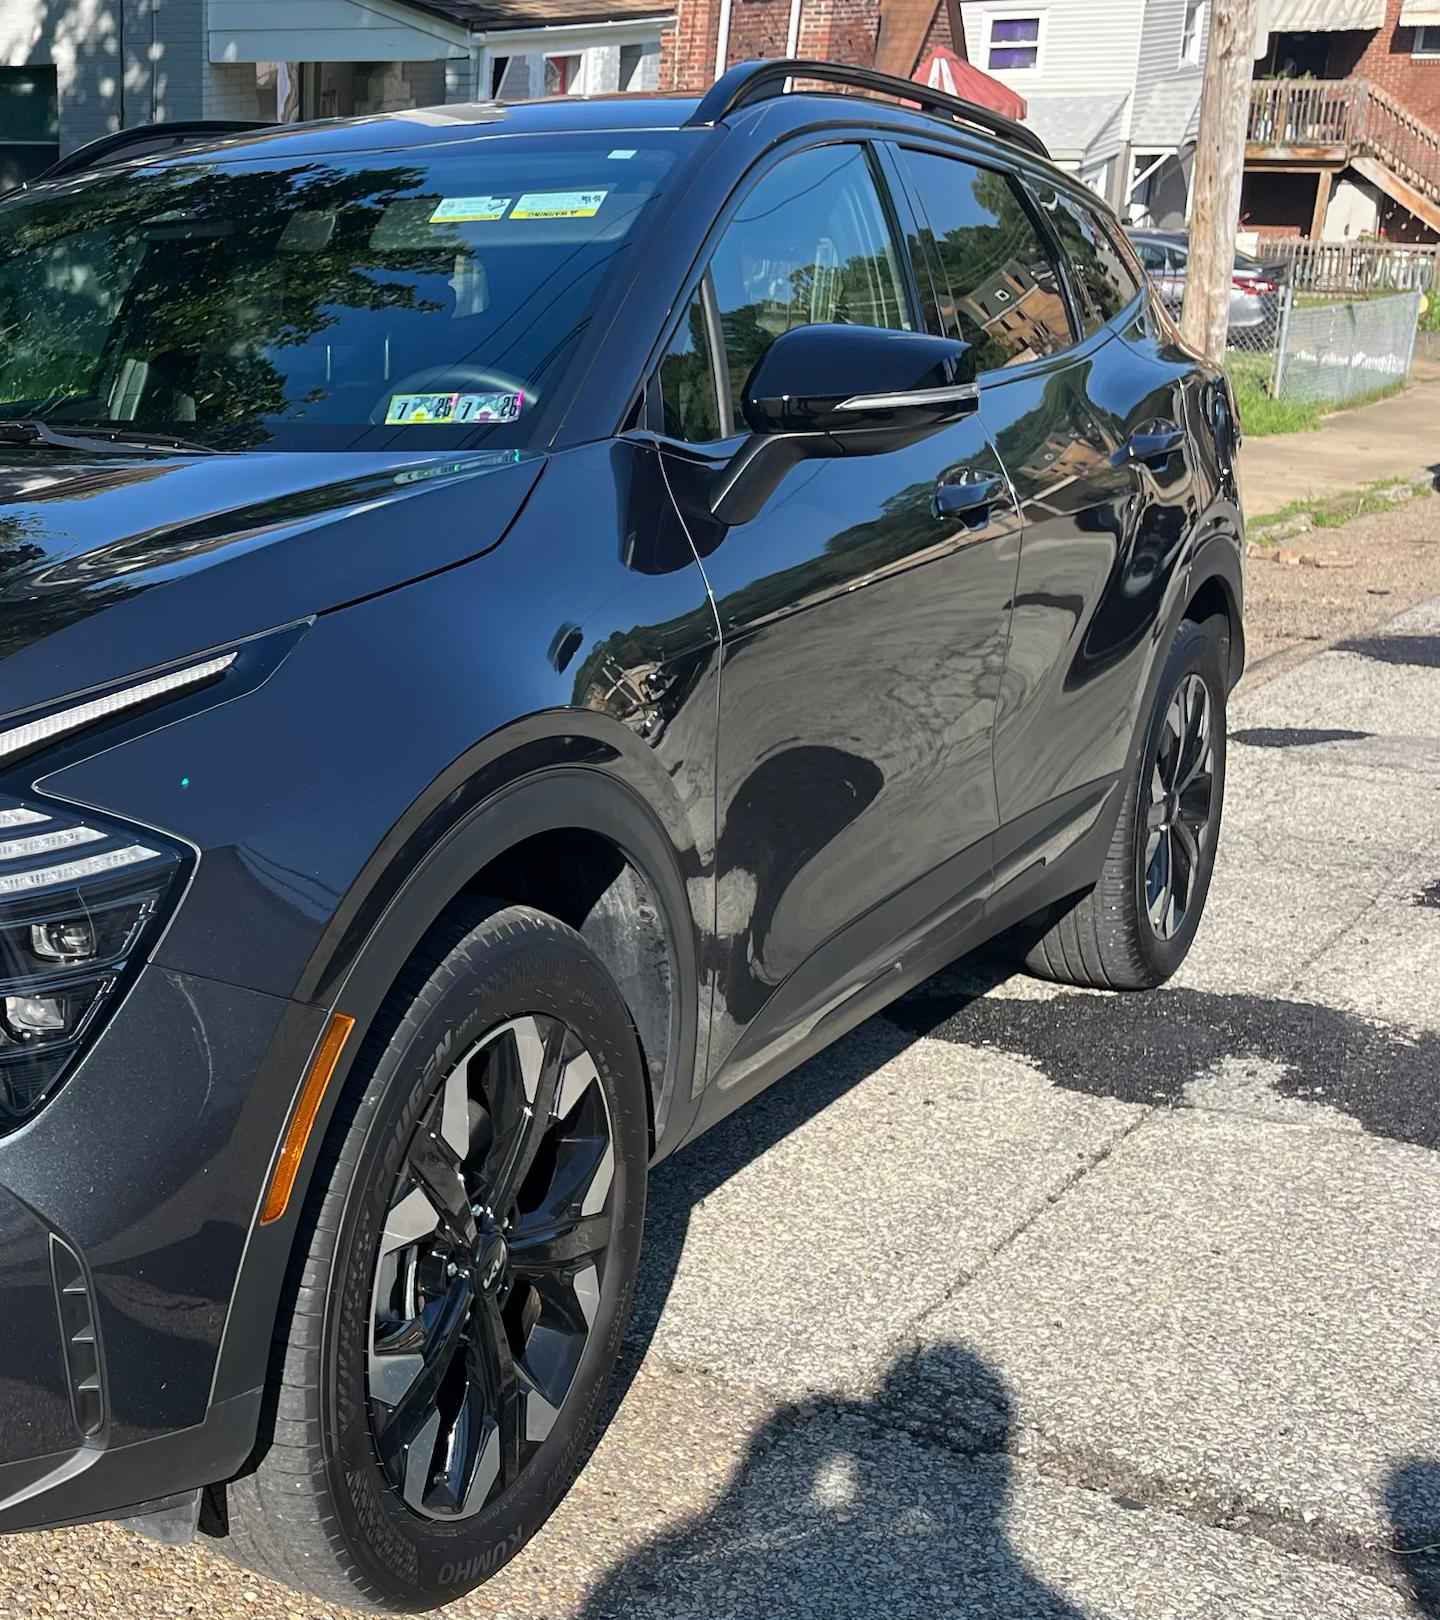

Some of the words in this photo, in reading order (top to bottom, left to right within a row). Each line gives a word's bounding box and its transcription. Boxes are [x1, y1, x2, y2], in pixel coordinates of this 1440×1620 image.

[397, 402, 409, 420] 7
[435, 396, 453, 418] 26
[461, 401, 473, 420] 7
[500, 396, 519, 418] 26
[437, 1523, 522, 1584] KUMHO
